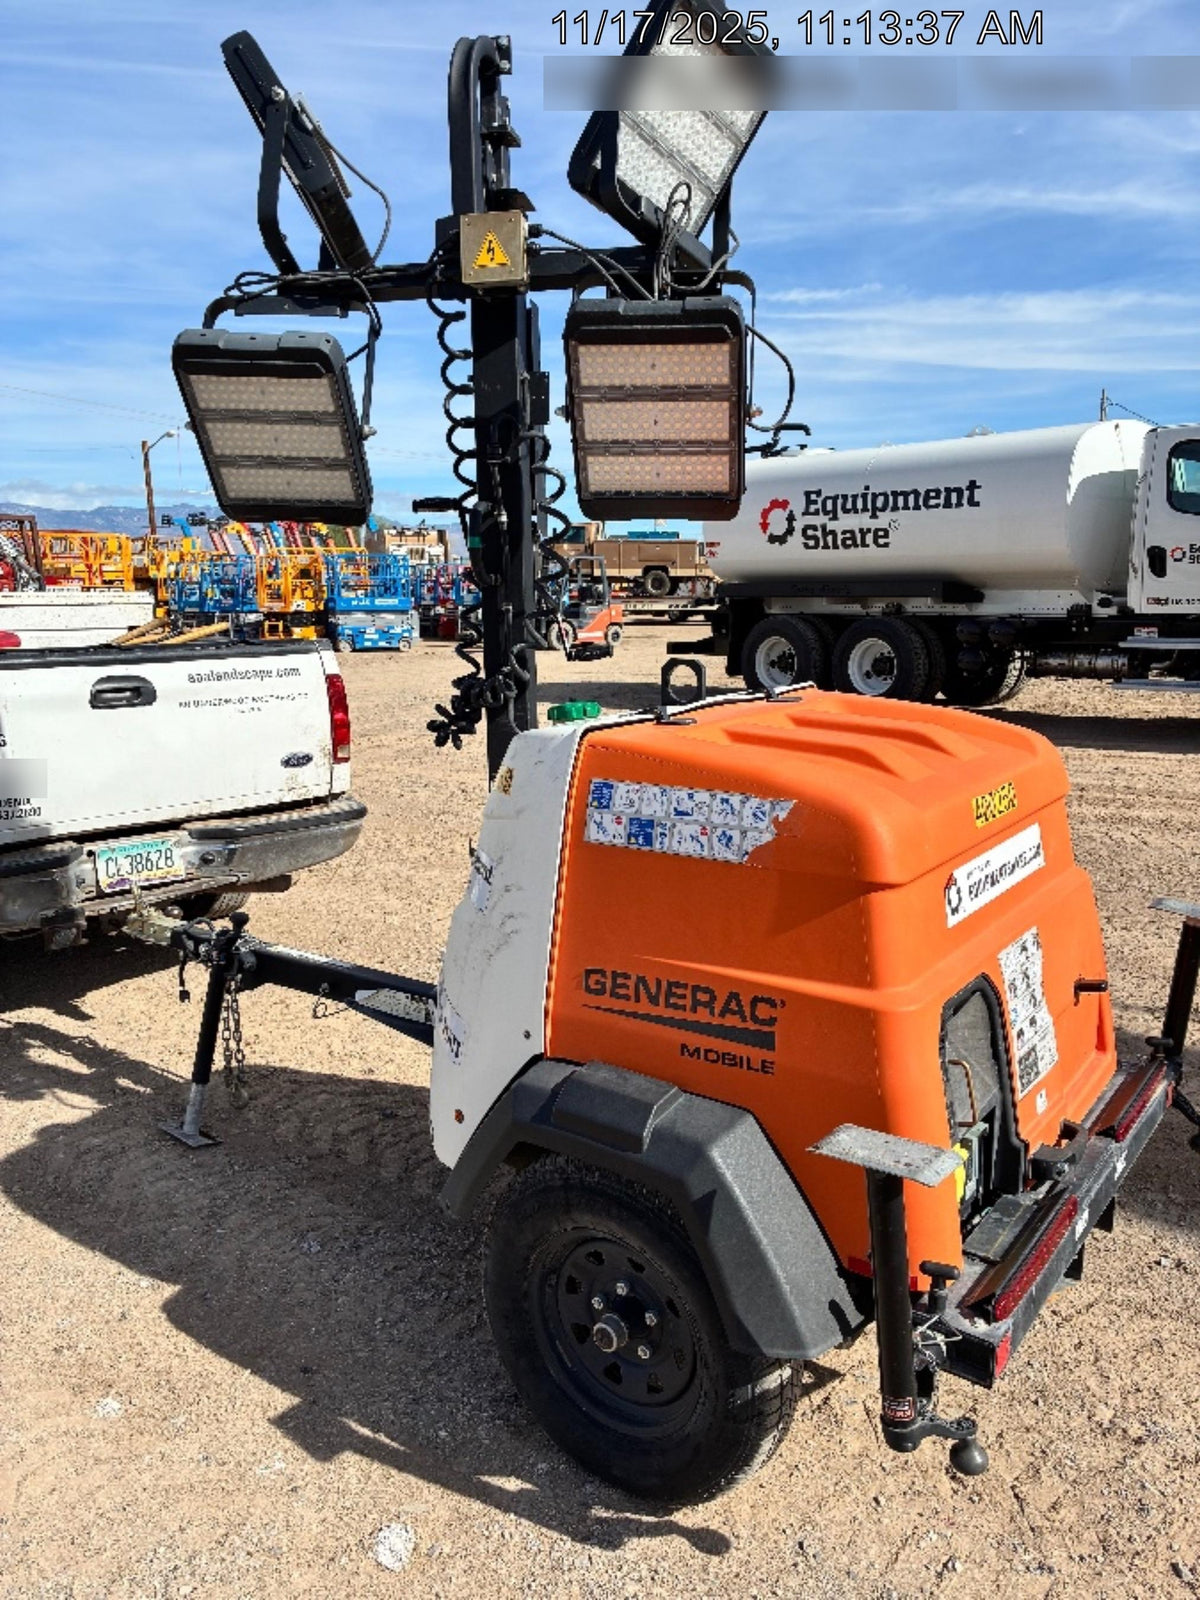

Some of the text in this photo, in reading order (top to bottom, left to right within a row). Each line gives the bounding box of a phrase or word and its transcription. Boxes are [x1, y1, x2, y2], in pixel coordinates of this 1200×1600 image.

[801, 479, 982, 521] Equipment
[584, 968, 778, 1027] GENERAC
[679, 1042, 776, 1076] MOBILE
